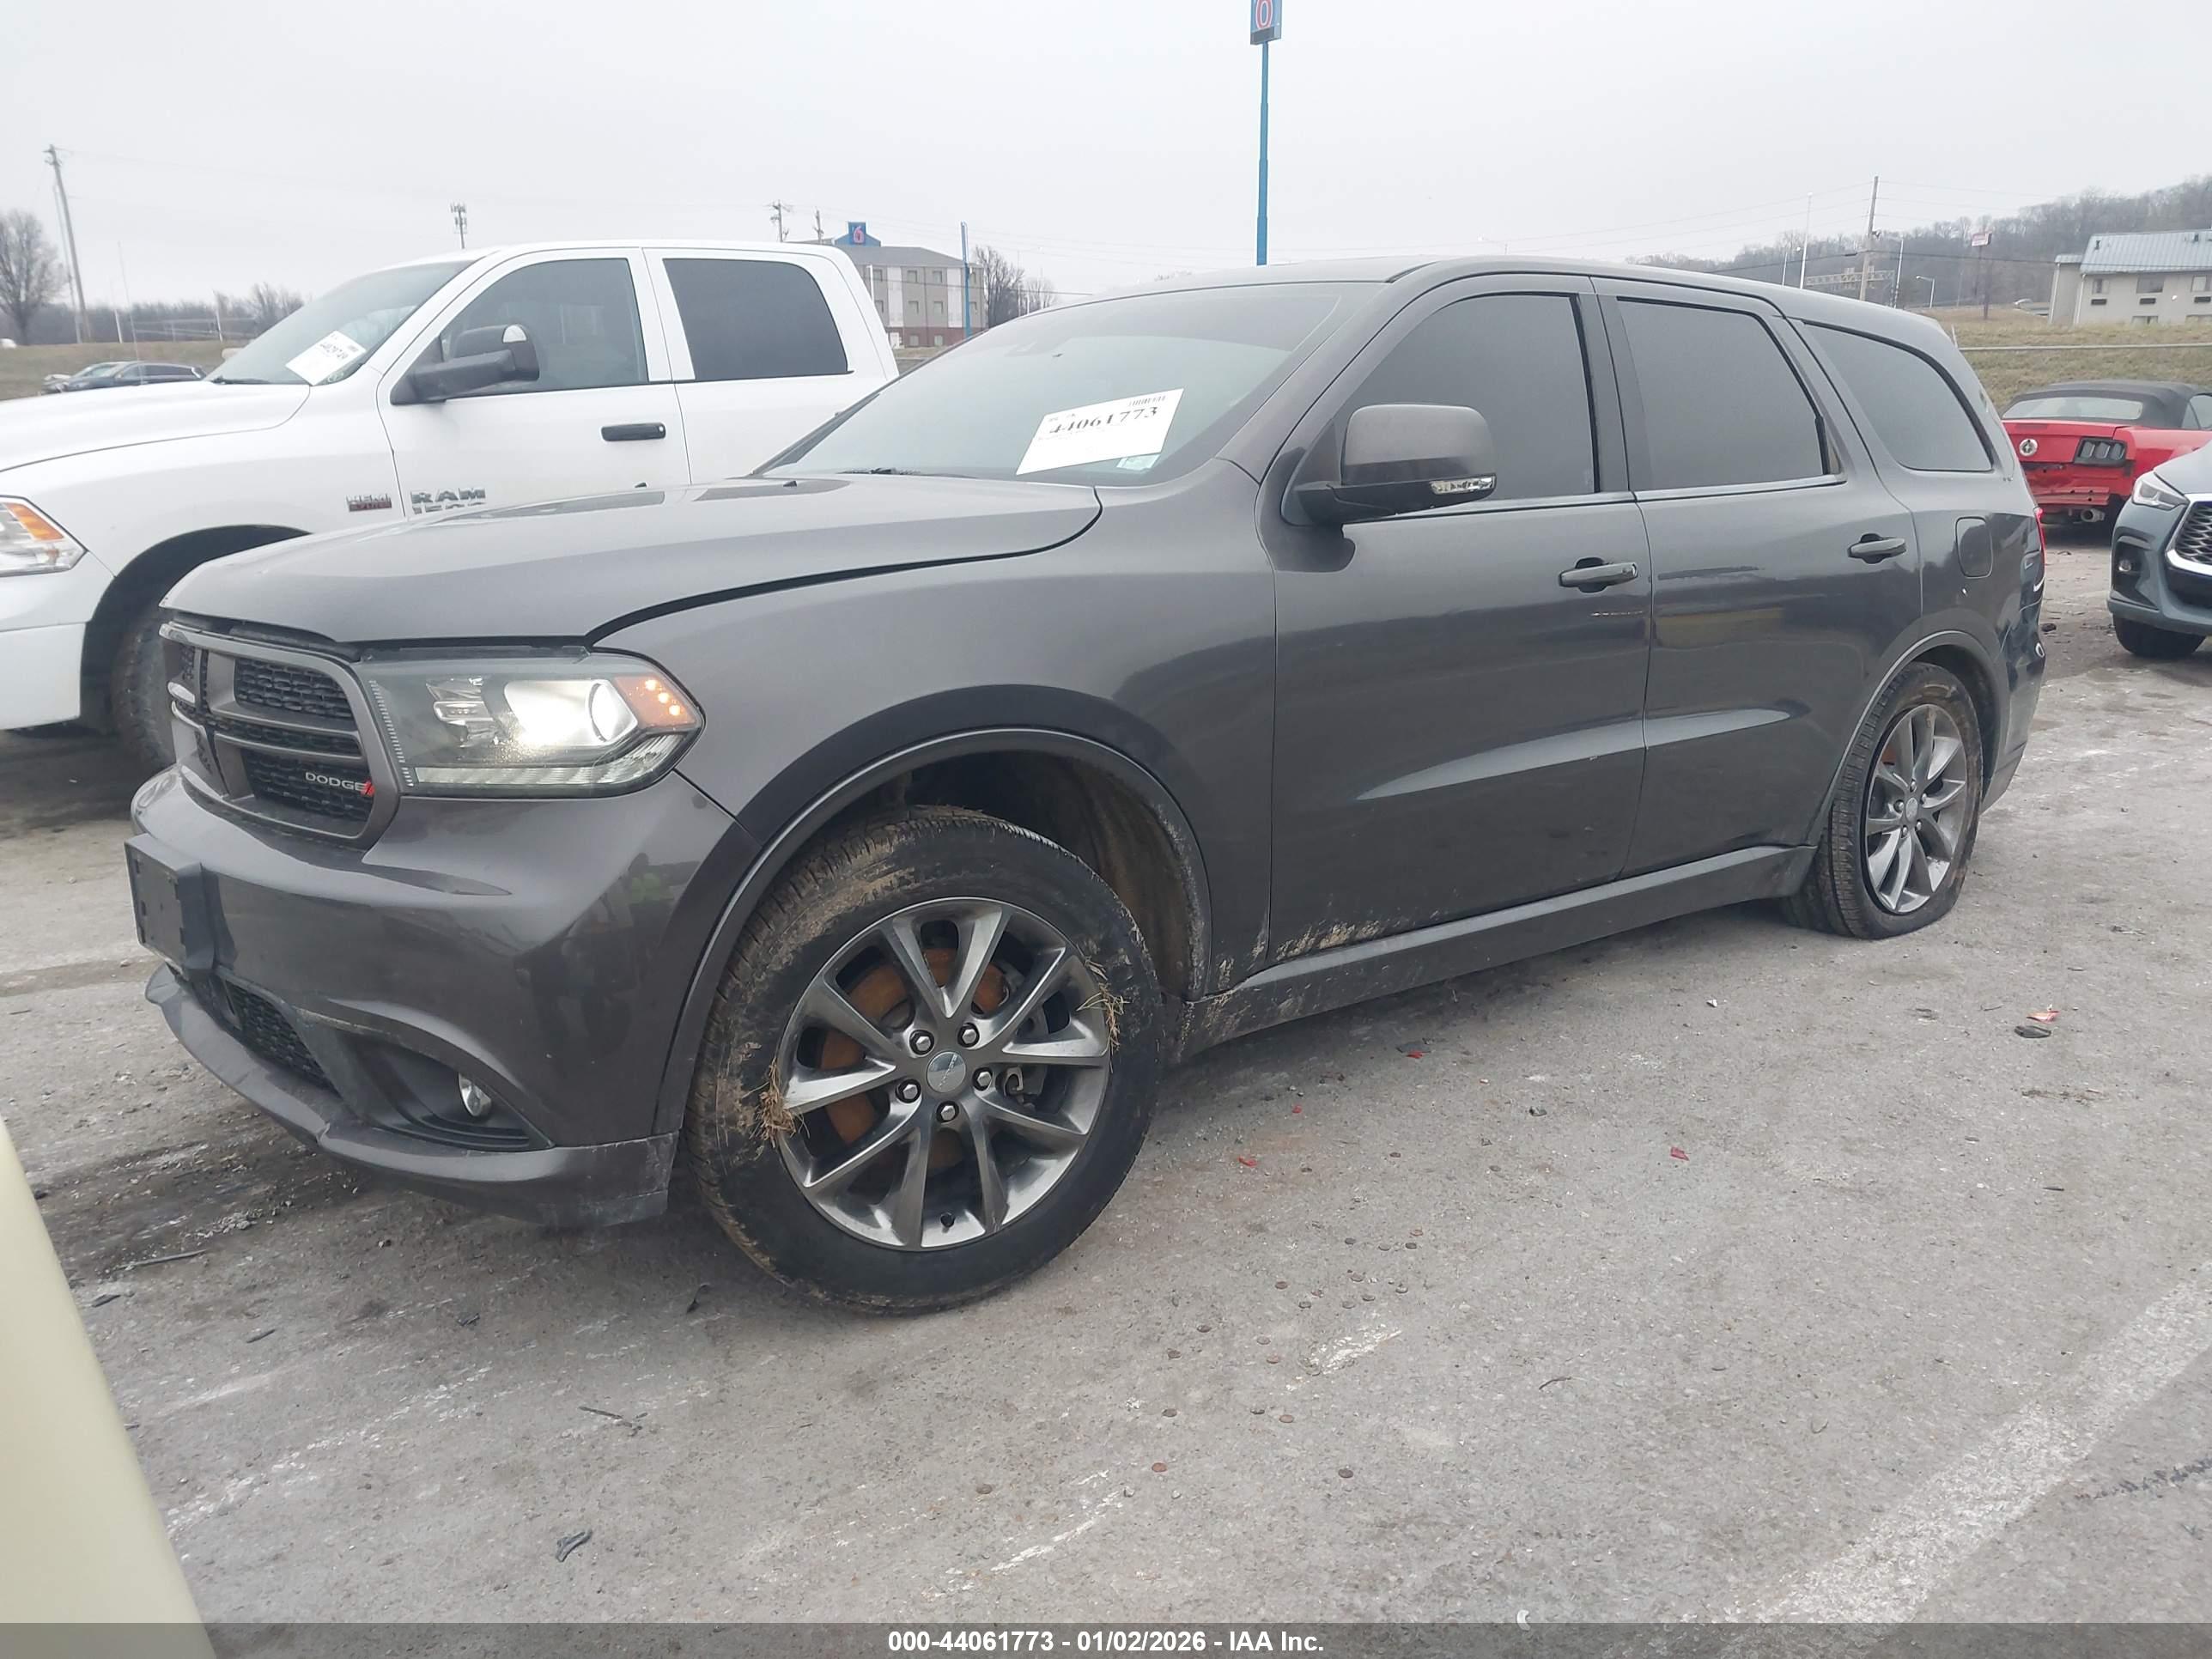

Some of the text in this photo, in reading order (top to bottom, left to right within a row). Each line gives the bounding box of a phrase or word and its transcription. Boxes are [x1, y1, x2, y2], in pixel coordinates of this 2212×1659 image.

[1049, 406, 1158, 434] 44061773
[410, 488, 486, 505] RAM
[305, 772, 367, 792] DODGE
